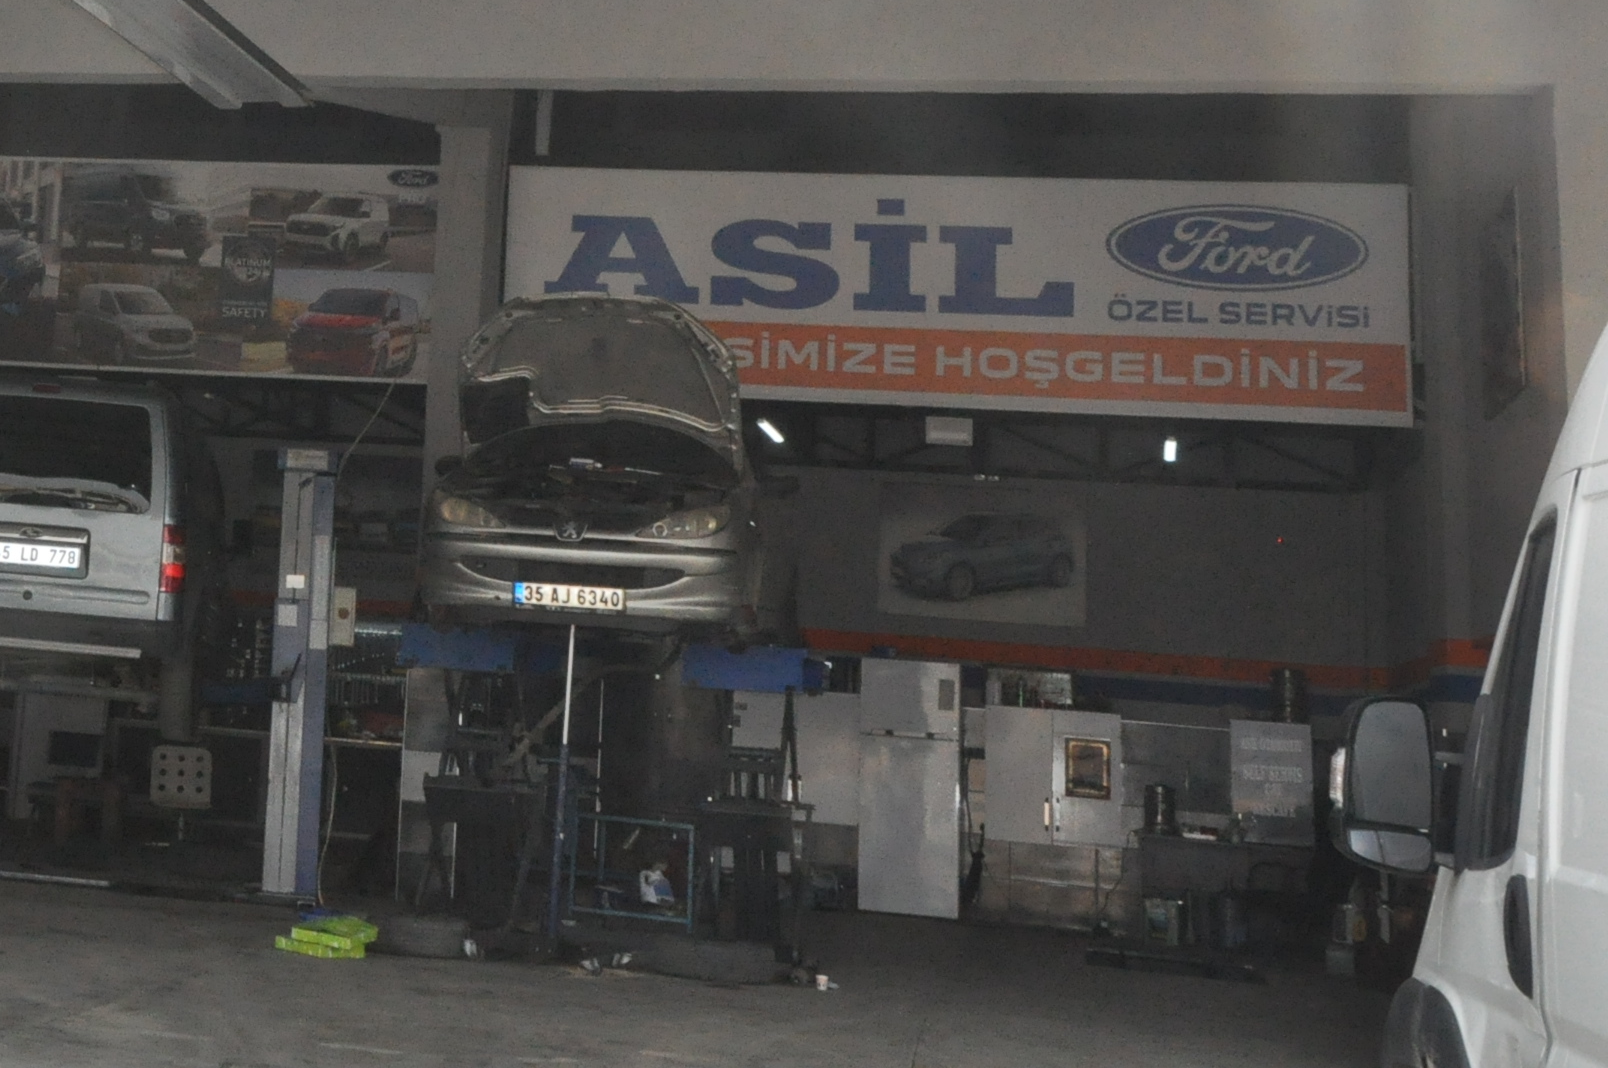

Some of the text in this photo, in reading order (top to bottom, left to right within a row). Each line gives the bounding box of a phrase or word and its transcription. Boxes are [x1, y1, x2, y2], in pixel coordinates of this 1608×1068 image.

[544, 197, 1076, 319] ASİL
[222, 307, 268, 318] SAFETY
[1107, 292, 1209, 324] ÖZEL
[935, 344, 1365, 393] HOŞGELDİNİZ
[20, 547, 39, 562] LD
[49, 549, 77, 565] 778
[524, 585, 621, 608] 35 AJ 6340
